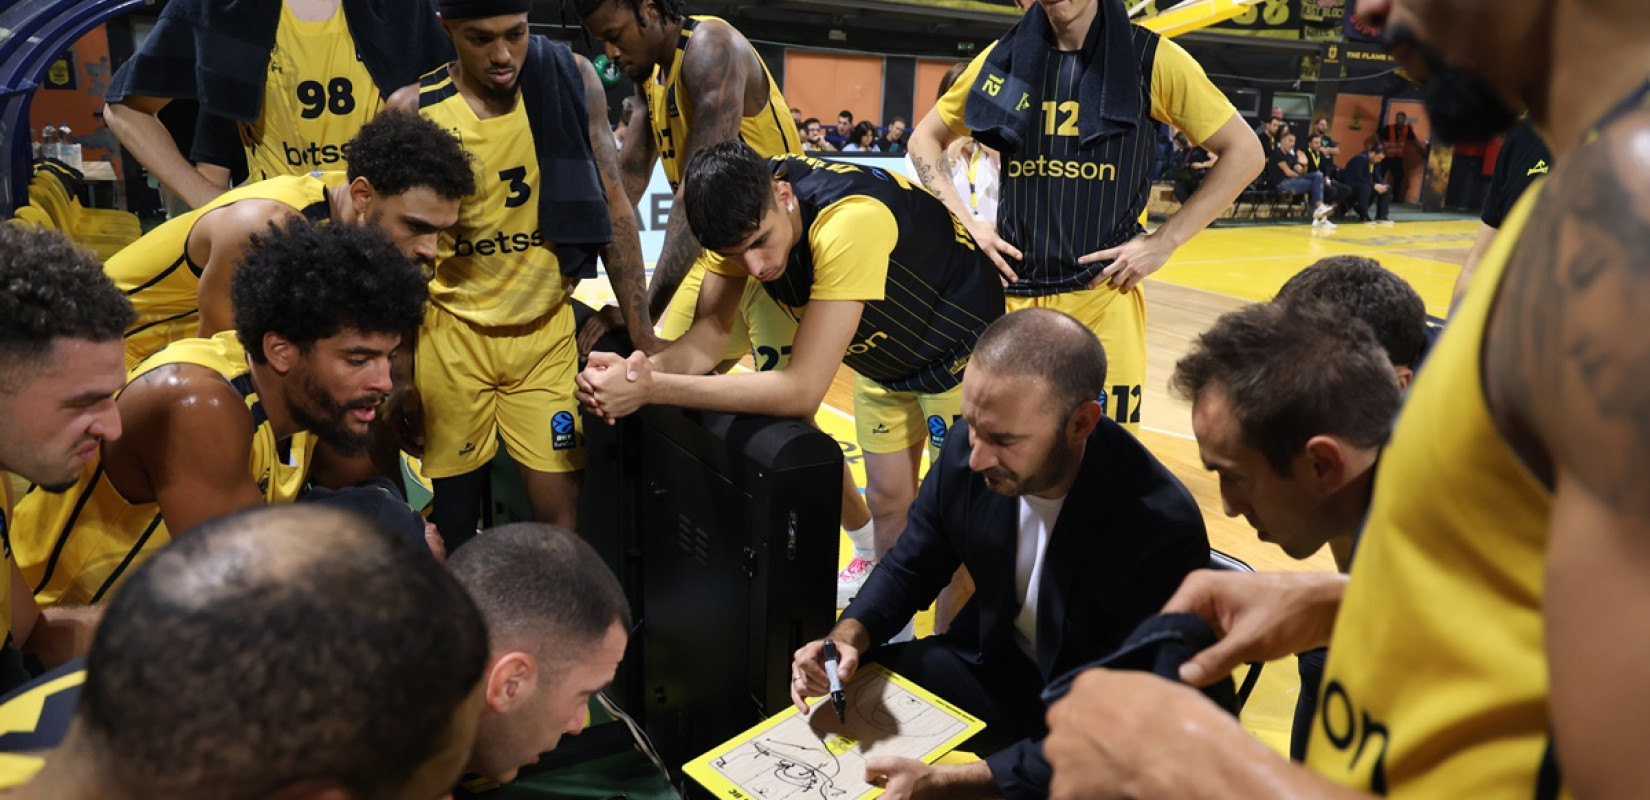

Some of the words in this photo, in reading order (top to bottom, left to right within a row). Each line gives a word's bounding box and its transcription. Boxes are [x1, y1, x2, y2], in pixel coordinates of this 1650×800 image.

[1346, 51, 1361, 59] THE
[297, 77, 355, 119] 98
[1041, 101, 1080, 137] 12
[1008, 155, 1116, 181] betsson
[498, 166, 531, 208] 3
[1112, 385, 1141, 423] 12
